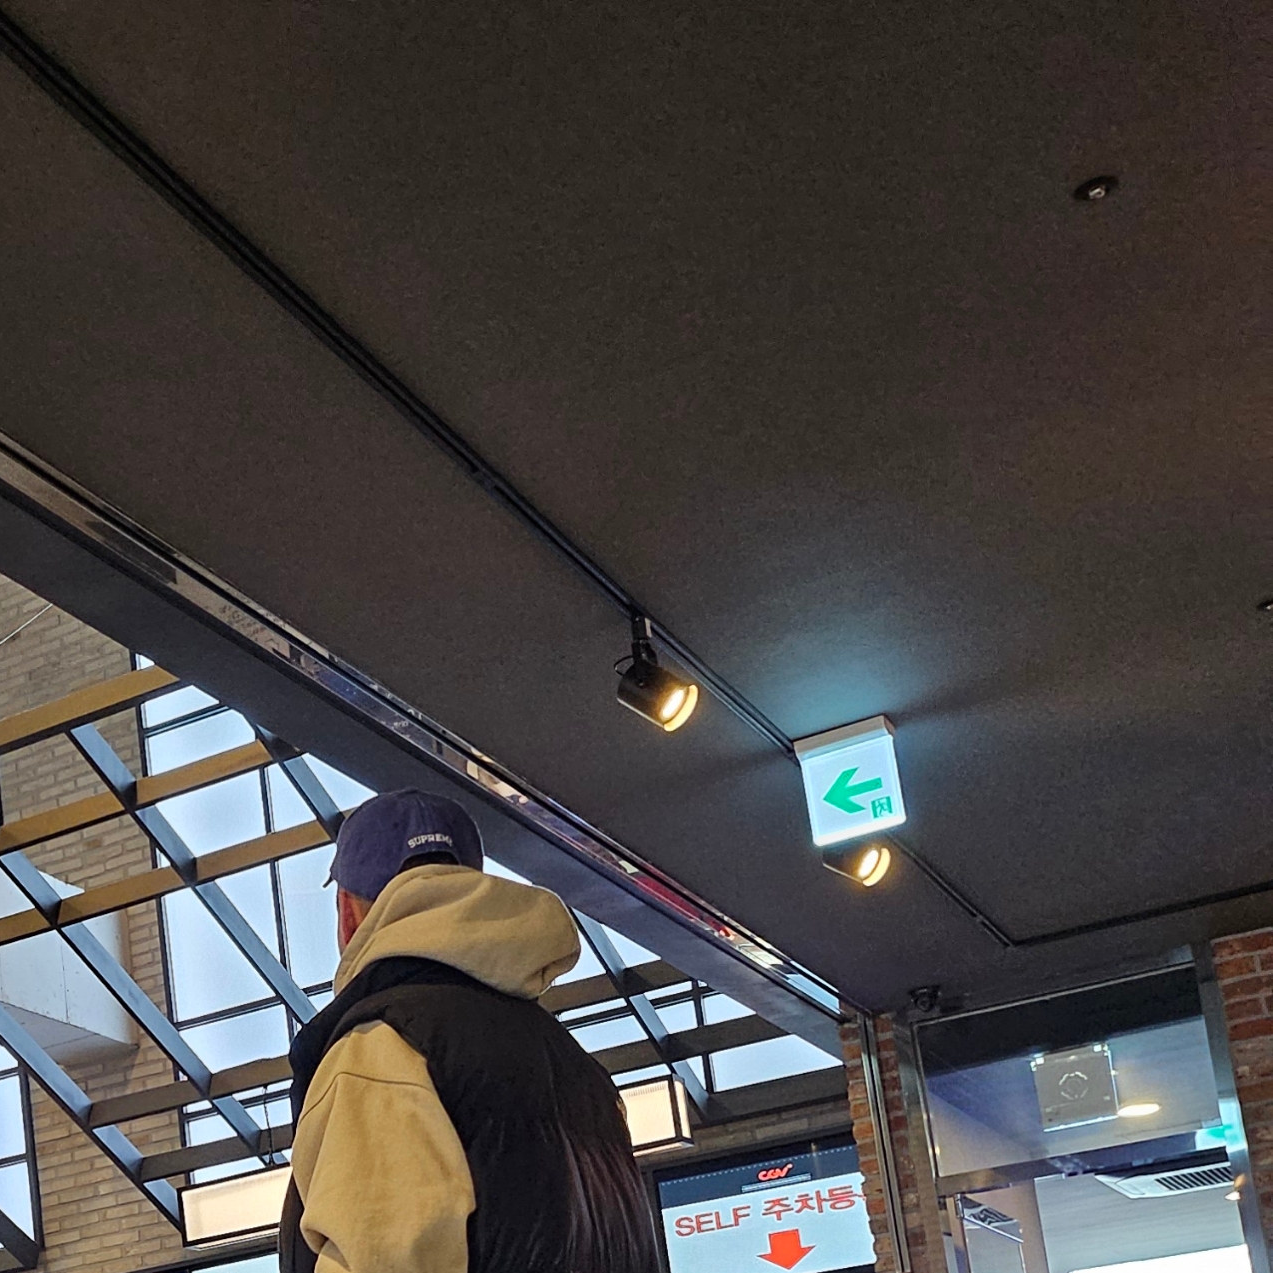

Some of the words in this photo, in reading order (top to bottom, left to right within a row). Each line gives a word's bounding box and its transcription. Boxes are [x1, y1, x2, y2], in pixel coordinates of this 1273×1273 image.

[758, 1164, 793, 1181] CGV
[674, 1205, 751, 1237] SELF
[762, 1184, 866, 1221] 주차등
